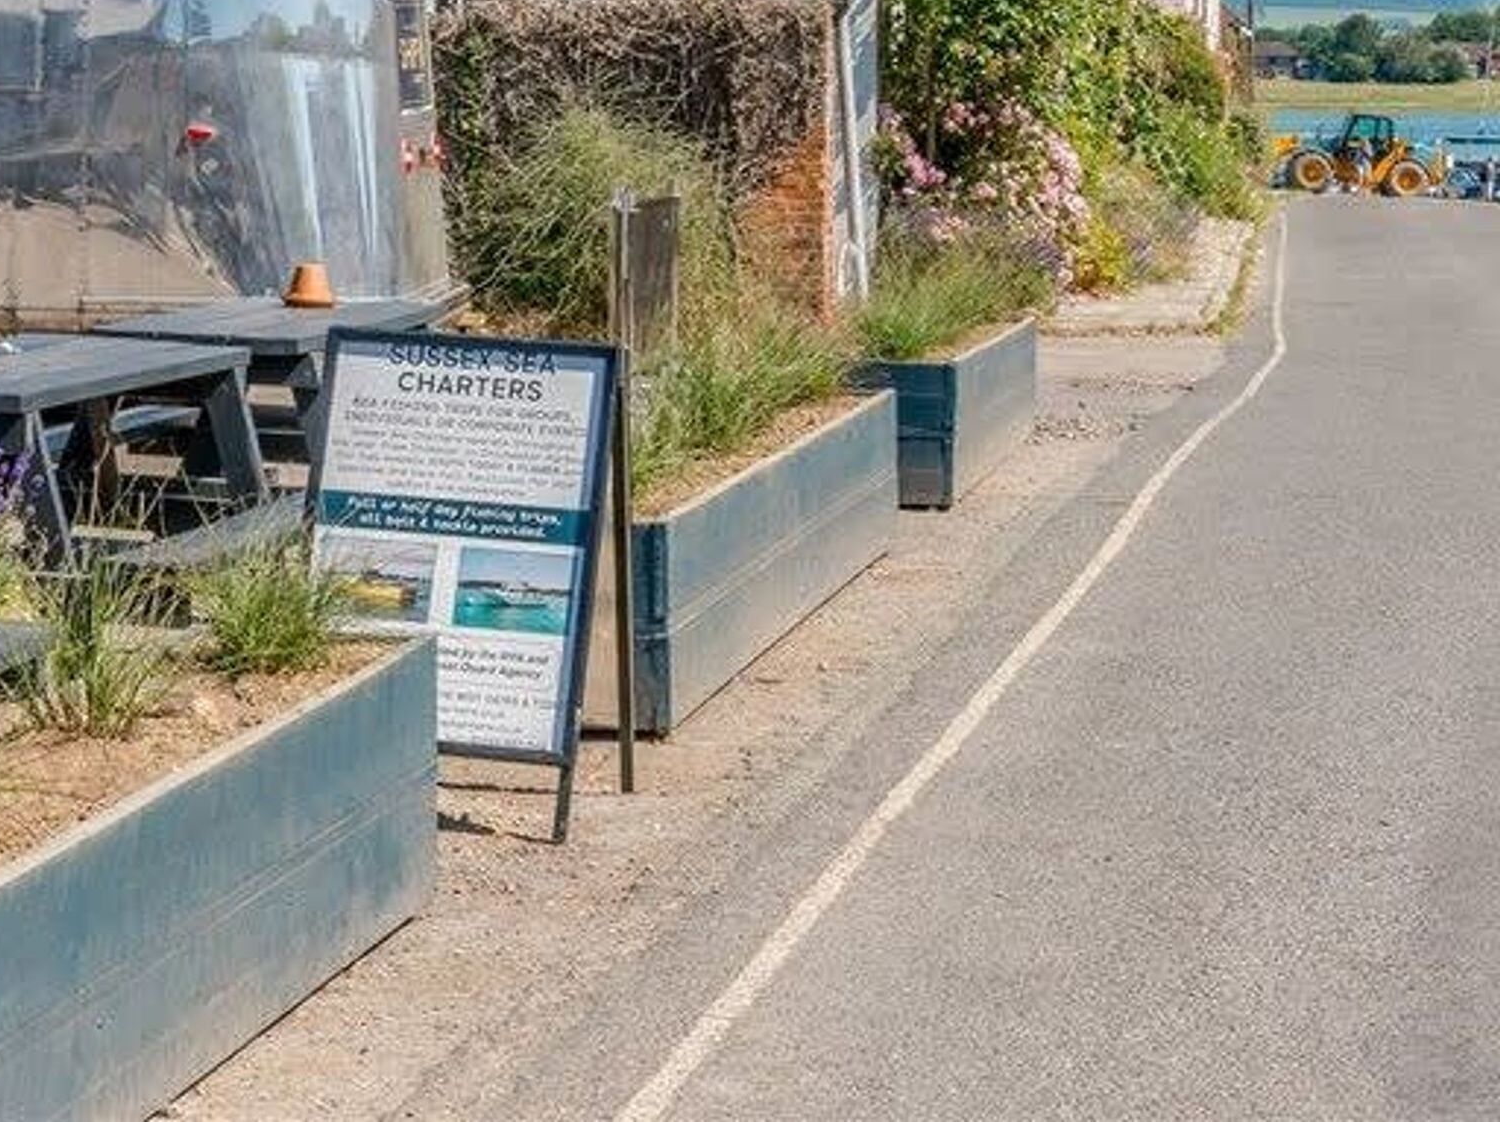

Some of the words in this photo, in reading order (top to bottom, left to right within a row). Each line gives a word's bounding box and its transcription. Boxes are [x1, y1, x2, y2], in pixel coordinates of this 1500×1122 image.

[388, 344, 491, 371] SUSSEX
[504, 350, 556, 375] SEA
[397, 371, 543, 402] CHARTERS
